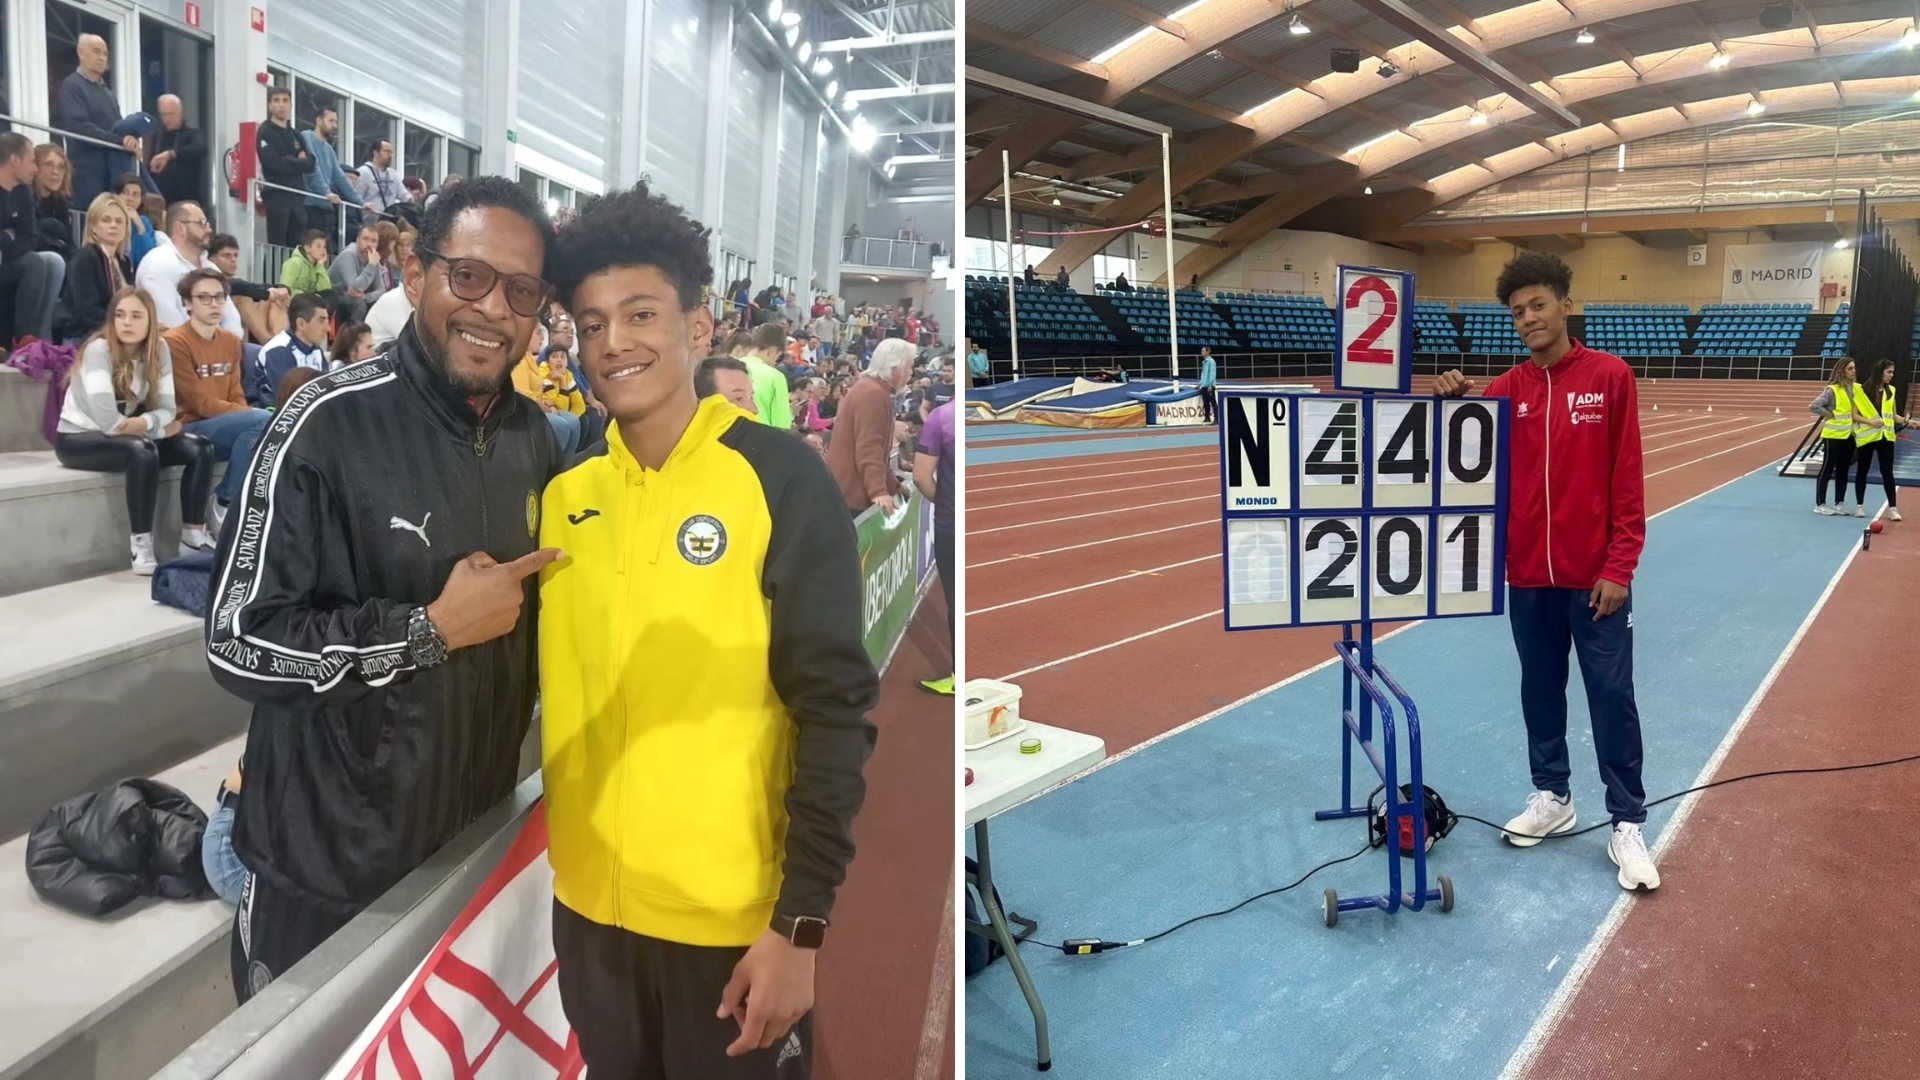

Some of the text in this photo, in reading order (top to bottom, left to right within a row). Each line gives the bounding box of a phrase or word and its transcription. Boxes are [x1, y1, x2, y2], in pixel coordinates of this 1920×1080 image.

[1751, 267, 1813, 281] MADRID
[1345, 275, 1398, 365] 2
[1575, 393, 1604, 405] ADM
[1304, 402, 1494, 485] 440
[1235, 497, 1278, 506] MONDO
[864, 528, 913, 640] IBERDROLA
[1305, 515, 1481, 600] 201
